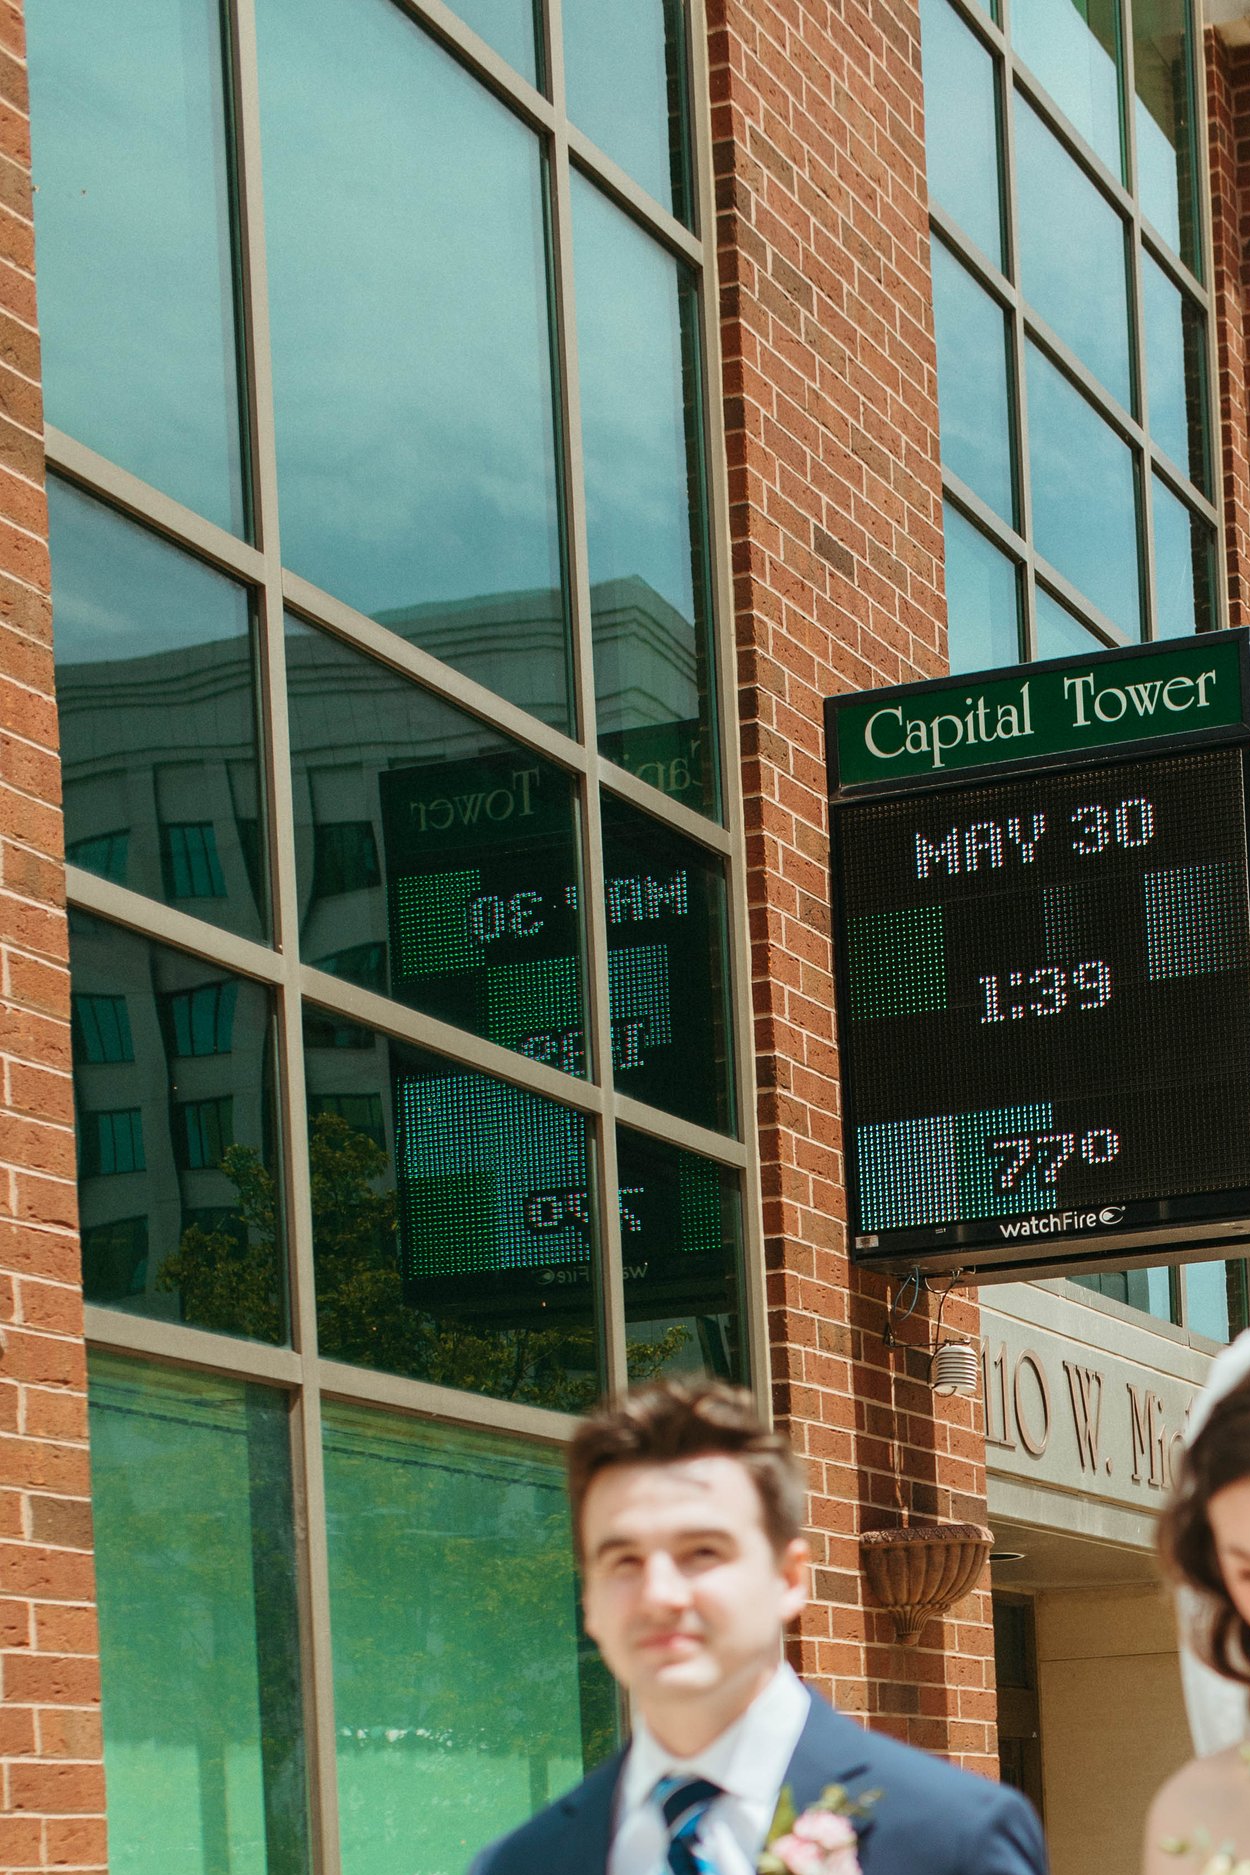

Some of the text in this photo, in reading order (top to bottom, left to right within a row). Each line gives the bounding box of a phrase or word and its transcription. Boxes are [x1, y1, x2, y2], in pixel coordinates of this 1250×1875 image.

[864, 669, 1217, 769] Capital Tower
[915, 797, 1155, 879] MAY 30
[978, 960, 1112, 1024] 1:39
[1000, 1211, 1096, 1238] watchFire
[980, 1335, 1193, 1489] 110 W. Mic
